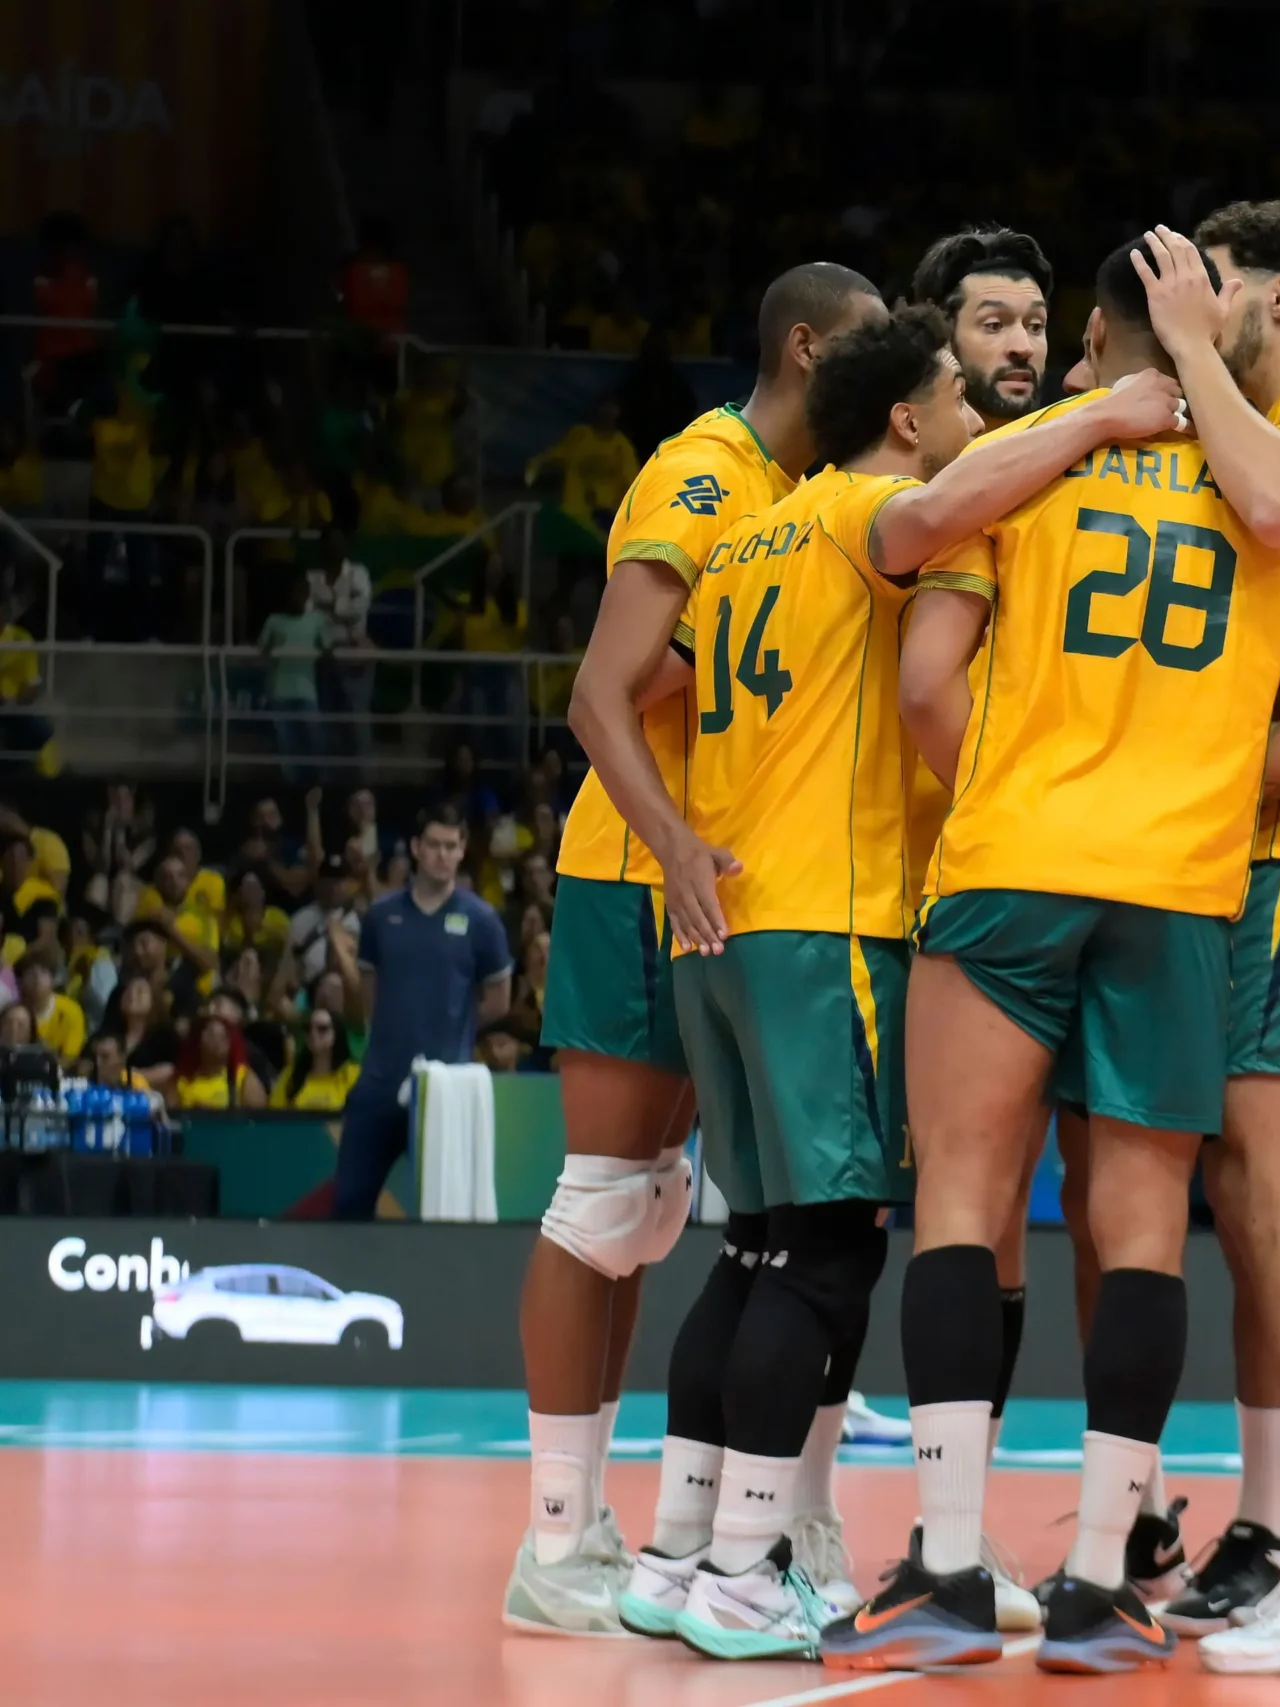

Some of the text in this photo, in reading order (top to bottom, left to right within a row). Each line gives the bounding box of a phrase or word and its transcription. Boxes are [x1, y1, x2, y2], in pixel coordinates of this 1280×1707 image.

[0, 57, 173, 133] AÍDA
[1064, 444, 1223, 500] DARLA
[1063, 506, 1238, 673] 28
[700, 584, 794, 735] 14
